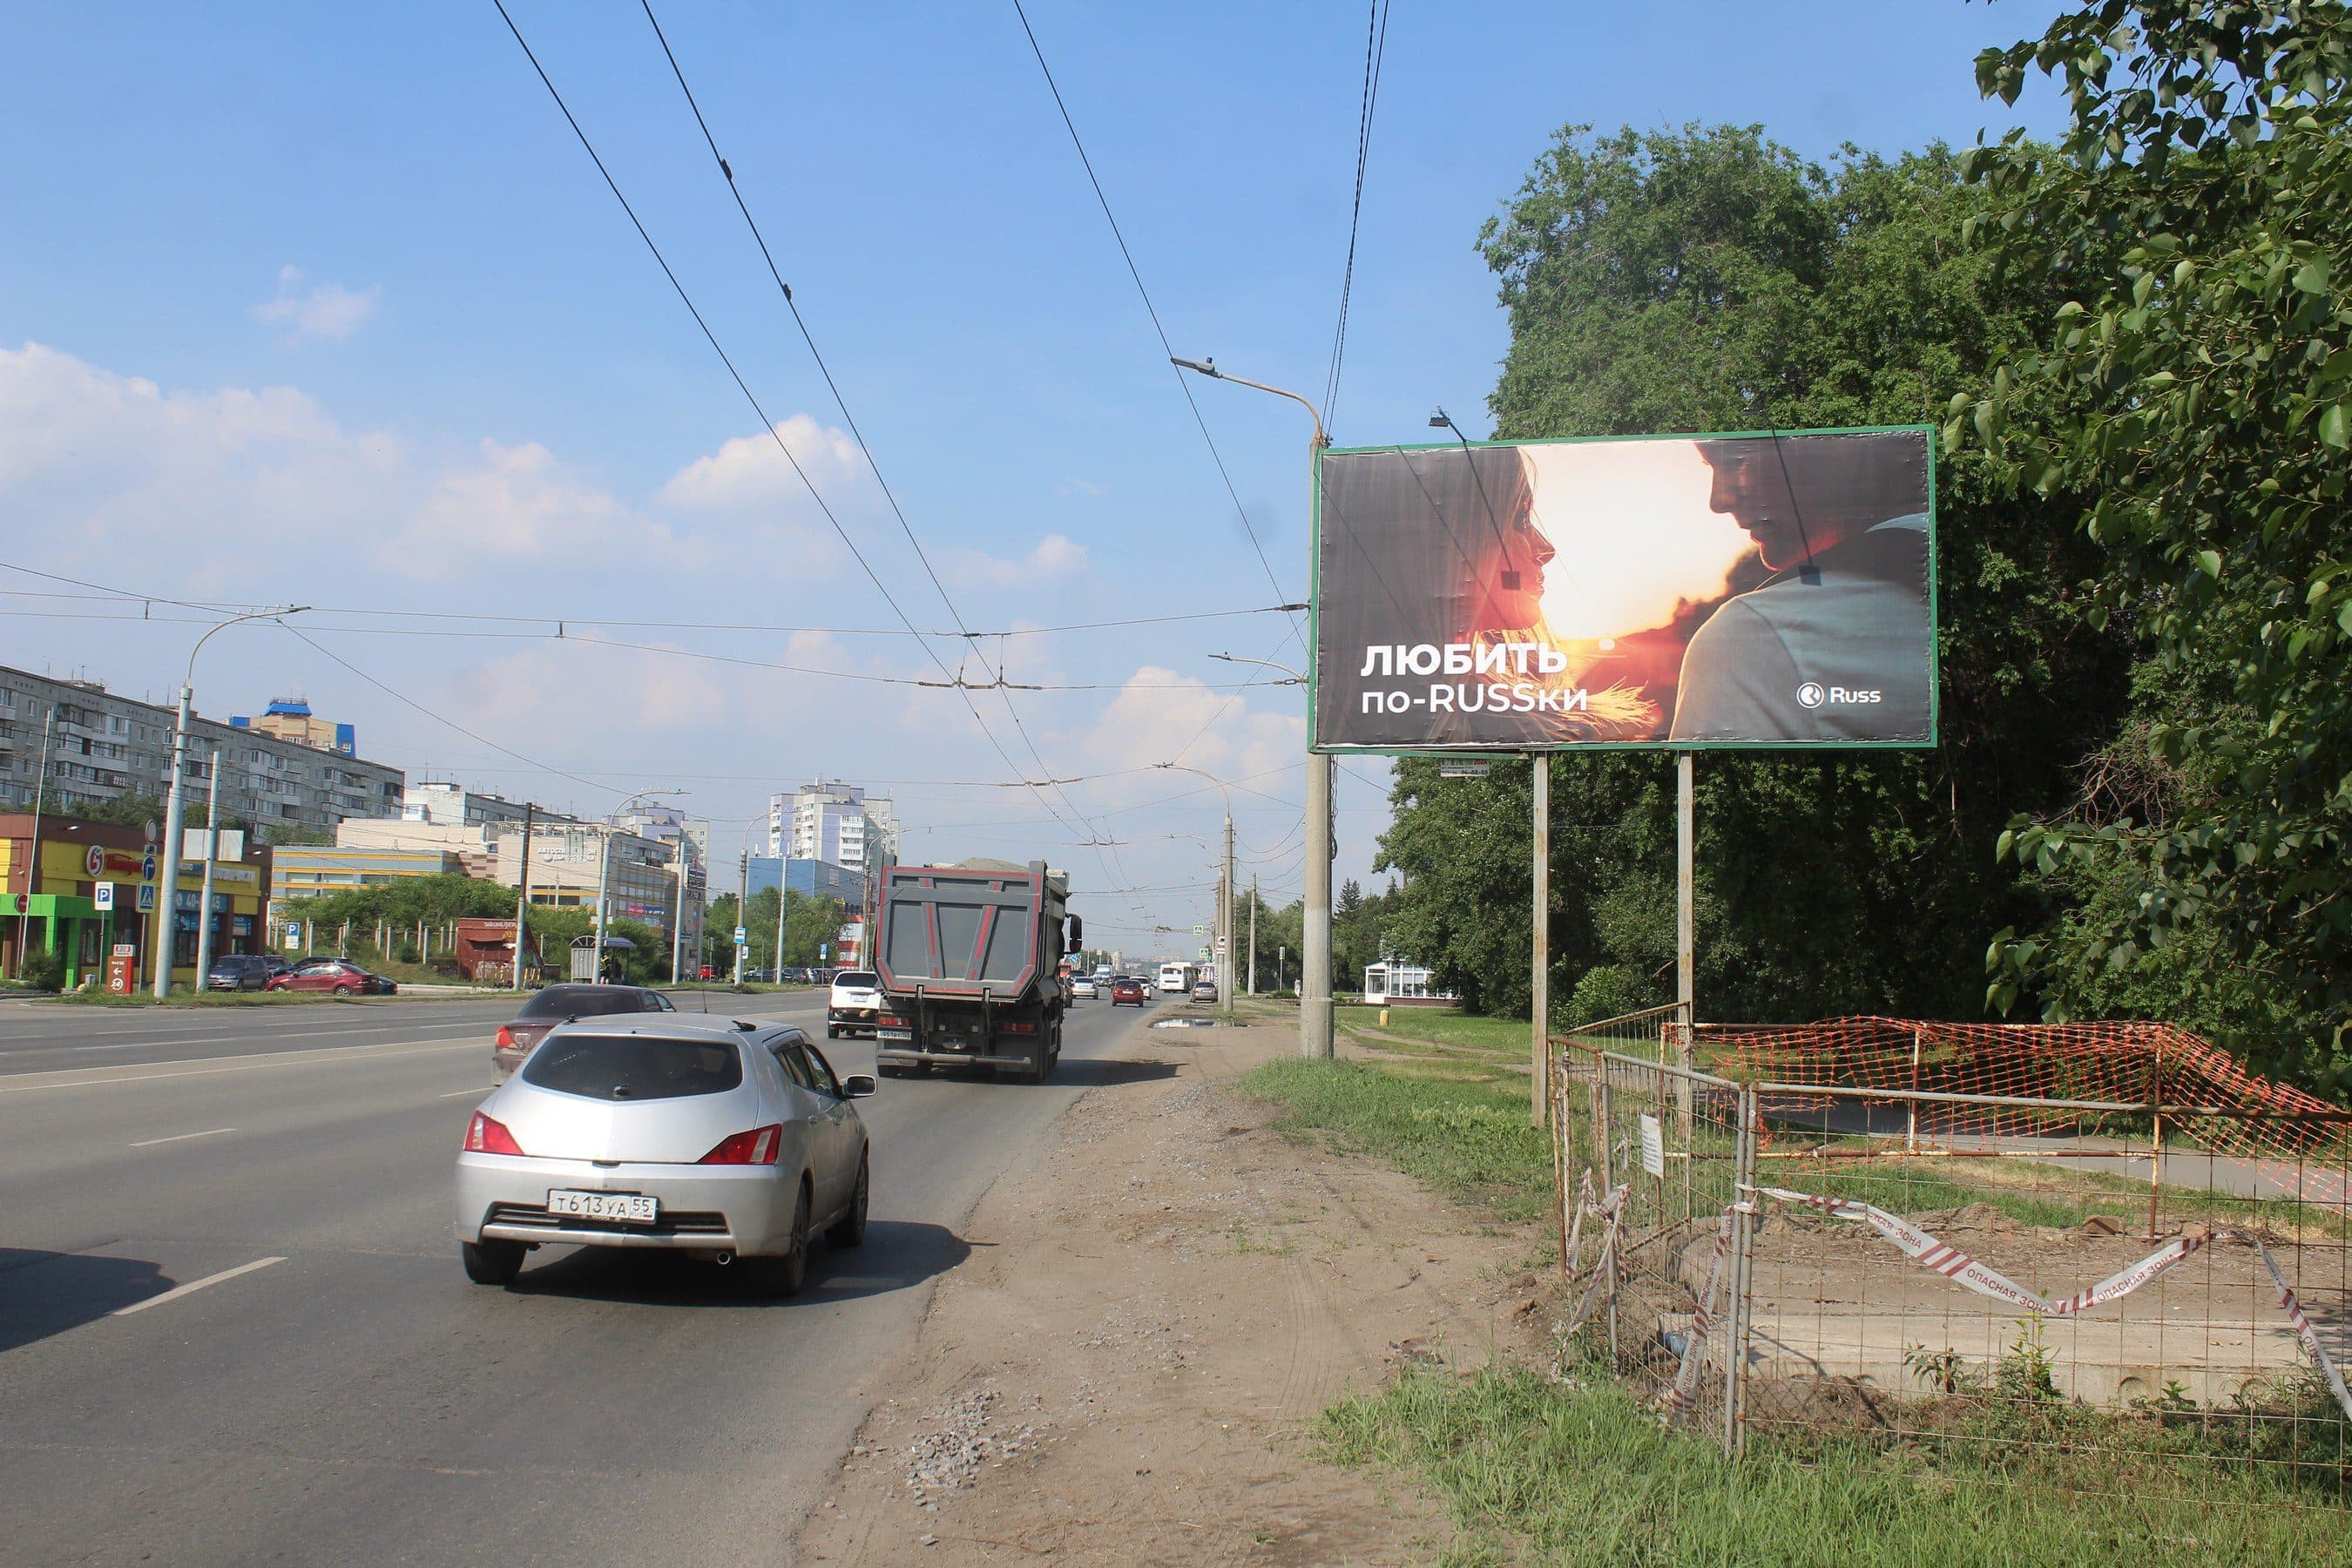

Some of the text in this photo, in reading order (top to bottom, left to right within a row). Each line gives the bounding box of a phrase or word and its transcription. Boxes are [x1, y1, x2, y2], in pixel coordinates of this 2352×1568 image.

[1361, 643, 1567, 677] ЛЮБИТЬ
[1361, 683, 1587, 714] по-RUSSки
[1829, 686, 1882, 705] Russ
[558, 1195, 650, 1215] Т613УА 55
[1896, 1227, 1923, 1249] ЗОНА
[1967, 1268, 2017, 1300] ОПАСНАЯ
[2097, 1254, 2175, 1302] ОПАСНАЯ ЗОНА
[1682, 1358, 1695, 1394] ОПАСНАЯ
